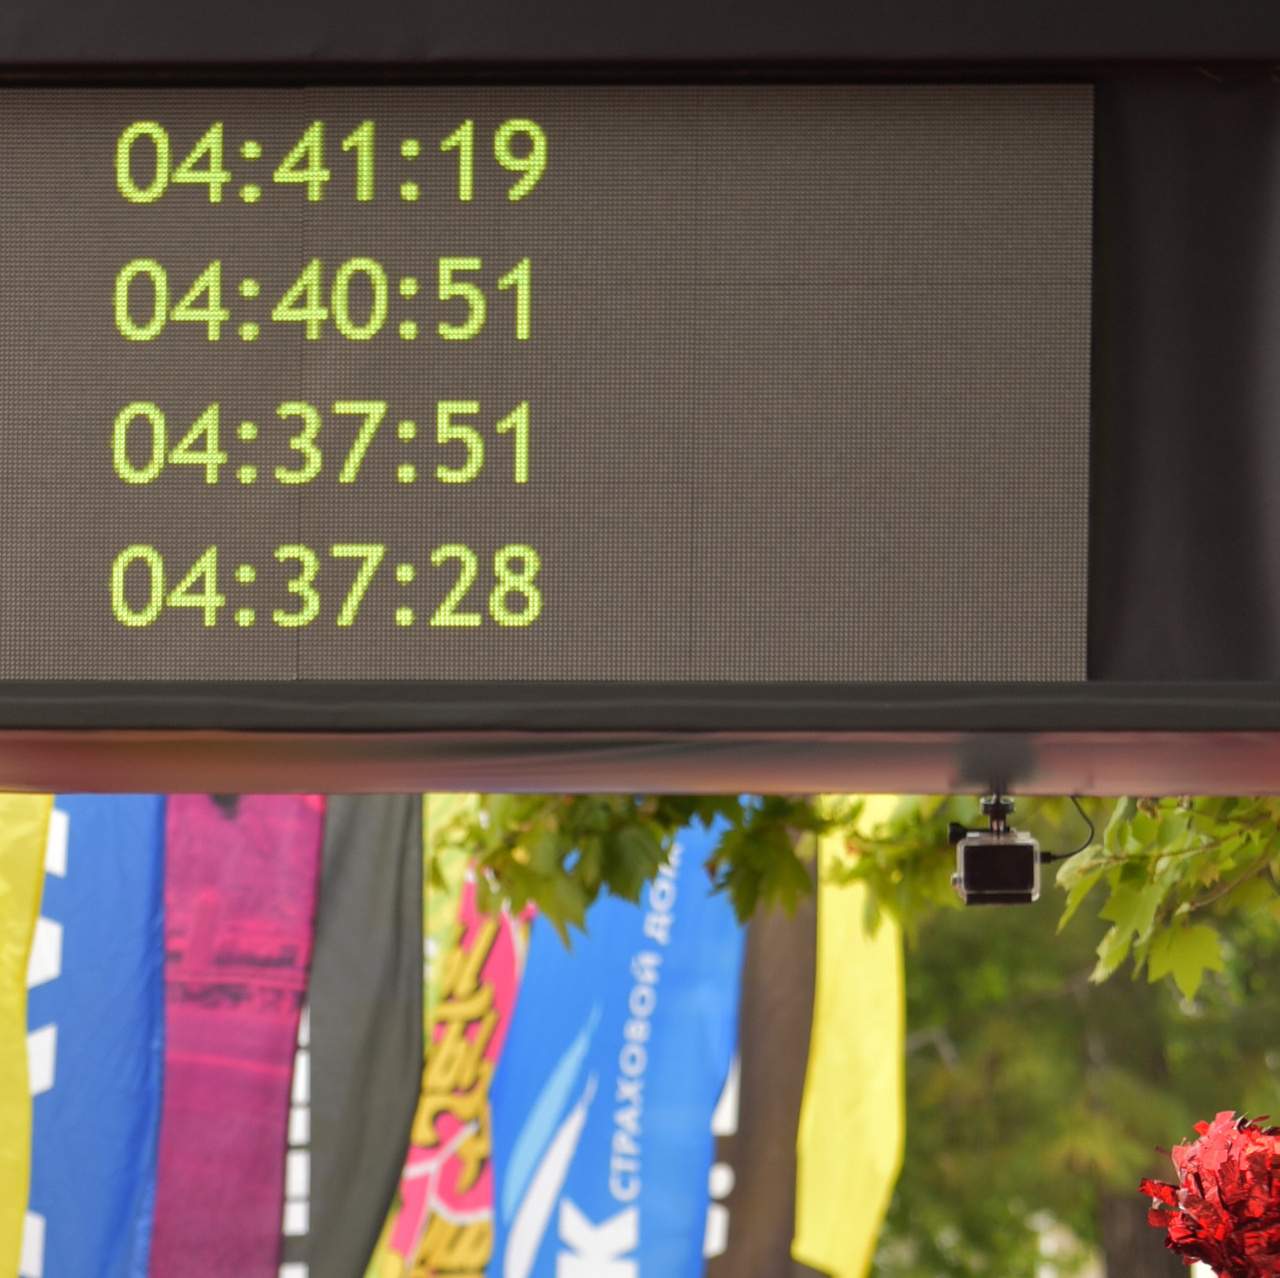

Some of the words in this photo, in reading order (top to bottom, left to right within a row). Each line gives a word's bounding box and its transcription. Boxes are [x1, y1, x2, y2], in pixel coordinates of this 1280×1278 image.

[115, 120, 548, 203] 04:41:19
[113, 258, 532, 342] 04:40:51
[111, 402, 531, 485] 04:37:51
[109, 545, 544, 628] 04:37:28
[608, 951, 664, 1203] СТРАХОВОЙ
